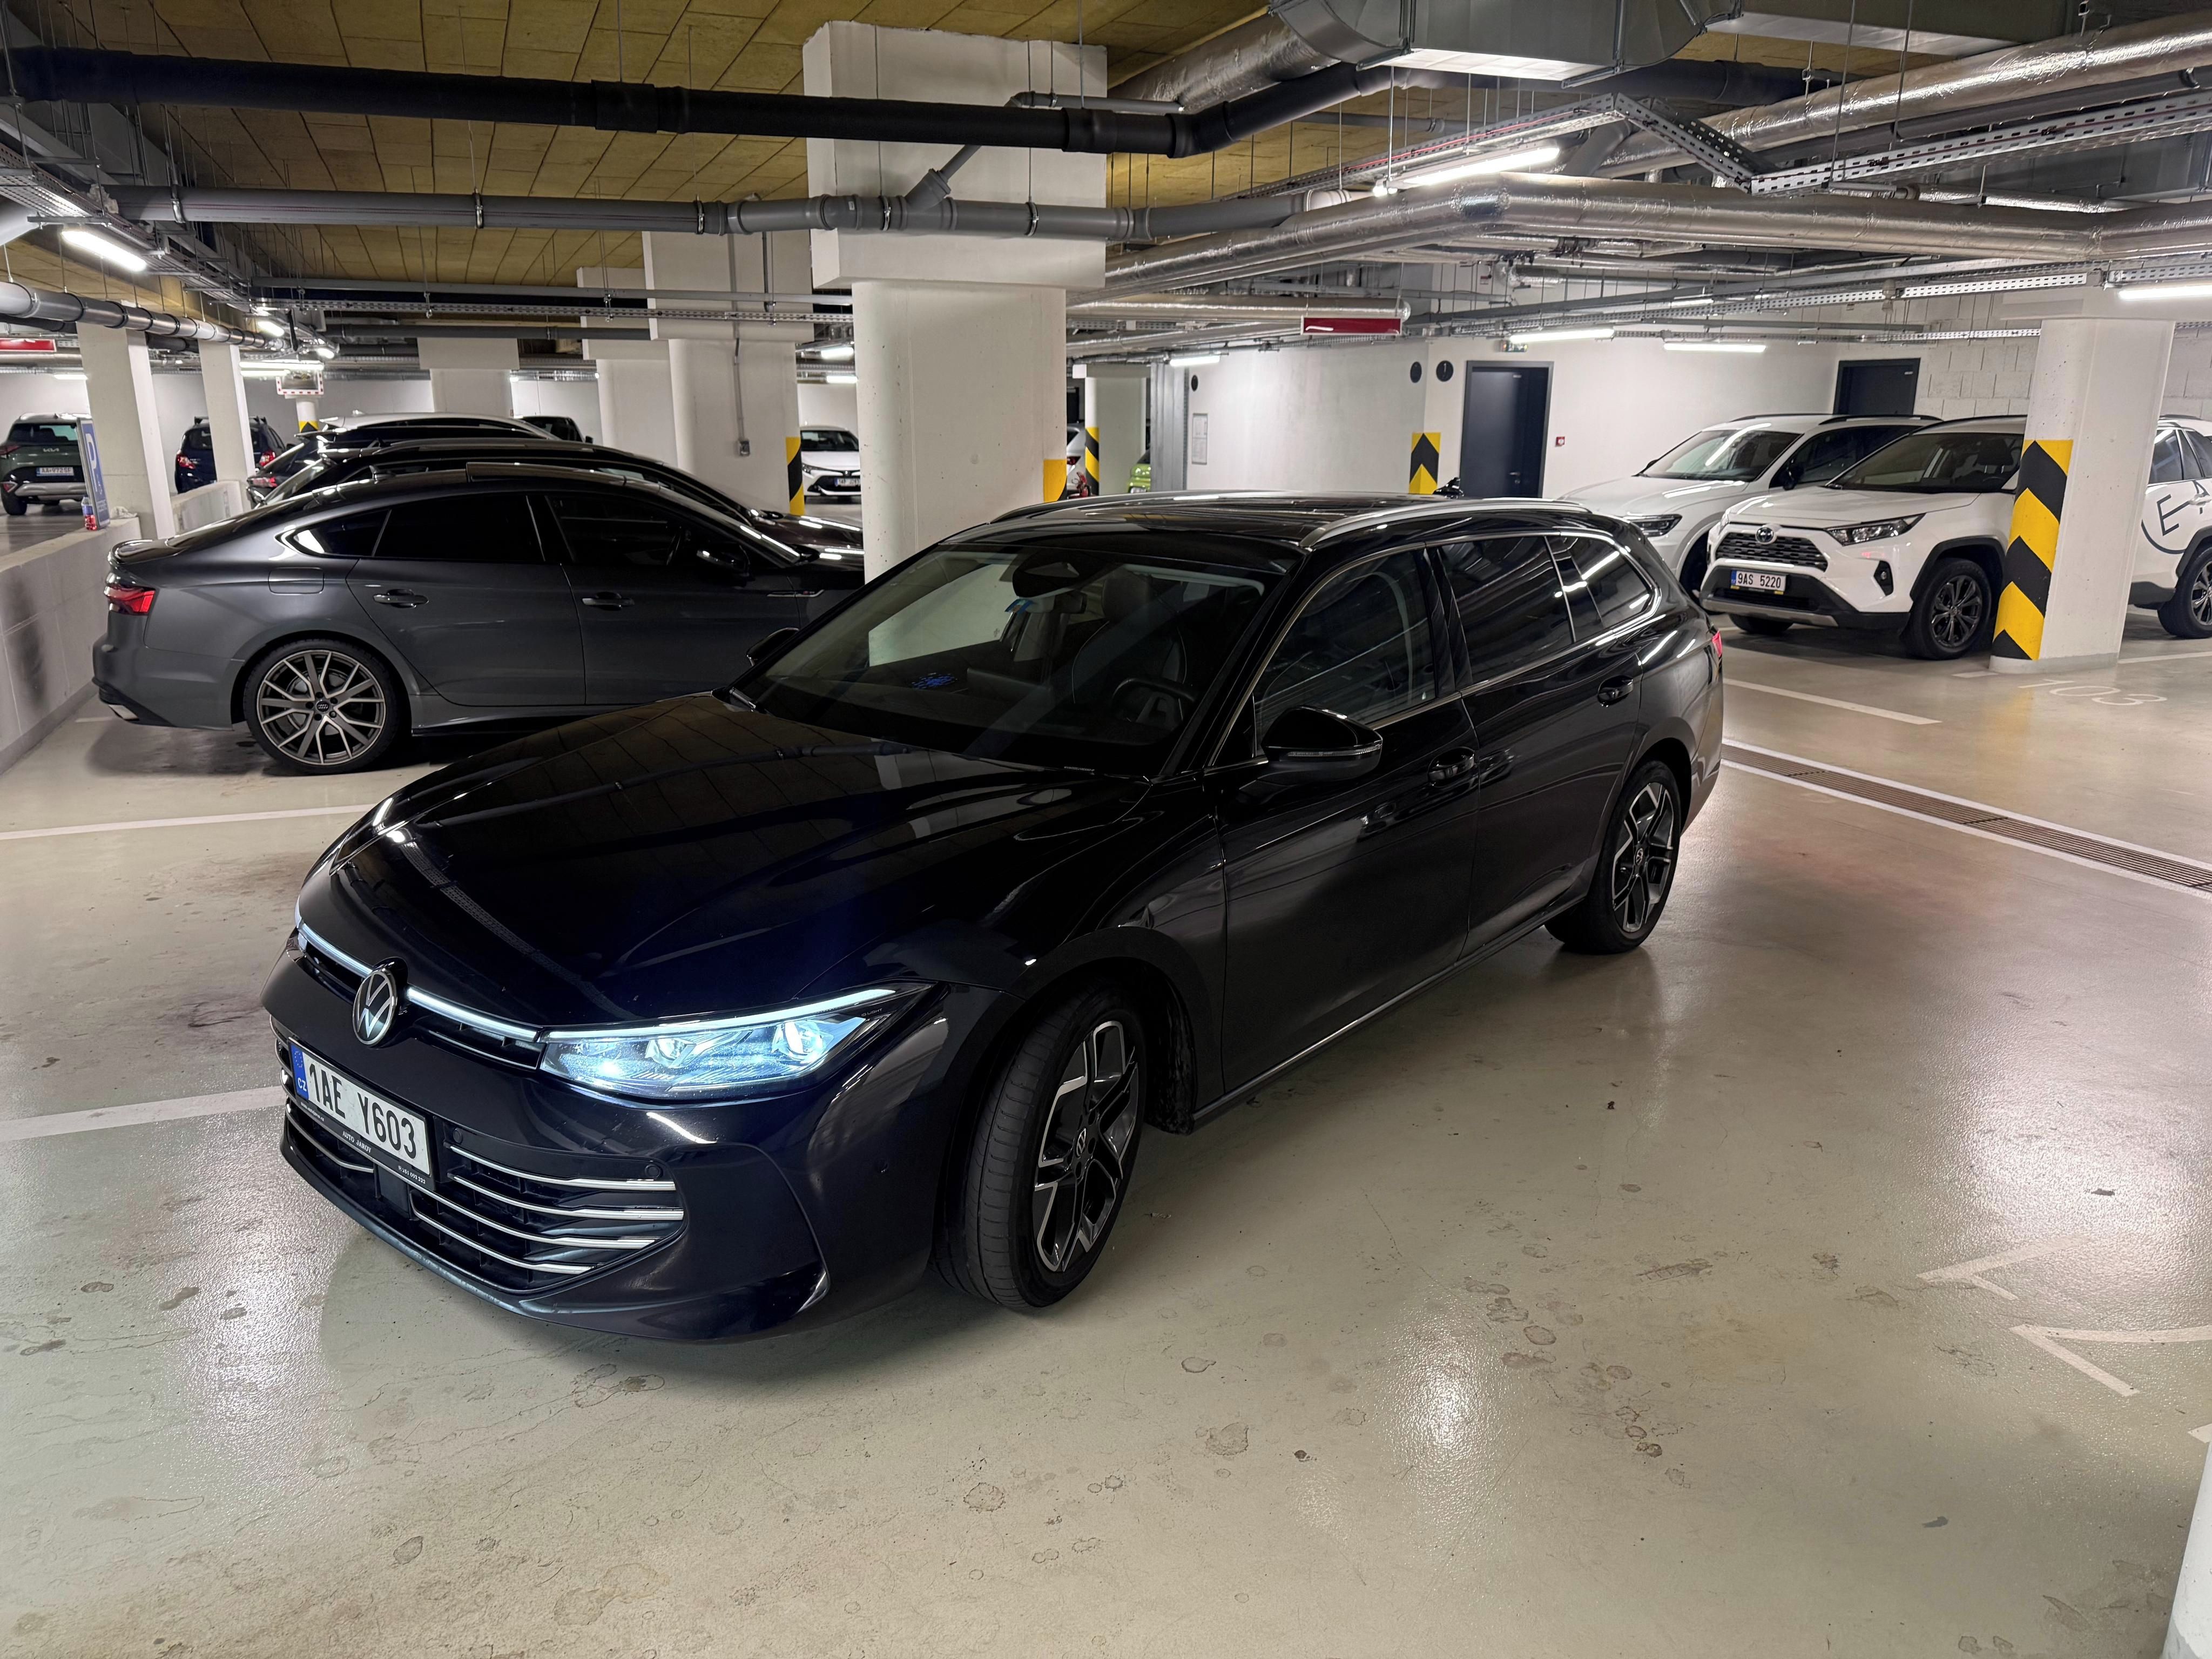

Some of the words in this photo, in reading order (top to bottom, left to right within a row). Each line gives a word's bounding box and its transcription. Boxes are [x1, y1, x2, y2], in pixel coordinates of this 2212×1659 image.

[1738, 572, 1754, 585] 9AS
[1760, 575, 1781, 589] 5220
[2018, 678, 2168, 706] 103
[298, 1077, 307, 1092] CZ
[309, 1063, 346, 1120] 1AE
[357, 1091, 416, 1159] Y603
[342, 1130, 355, 1143] AUTO
[356, 1139, 372, 1154] JAROV
